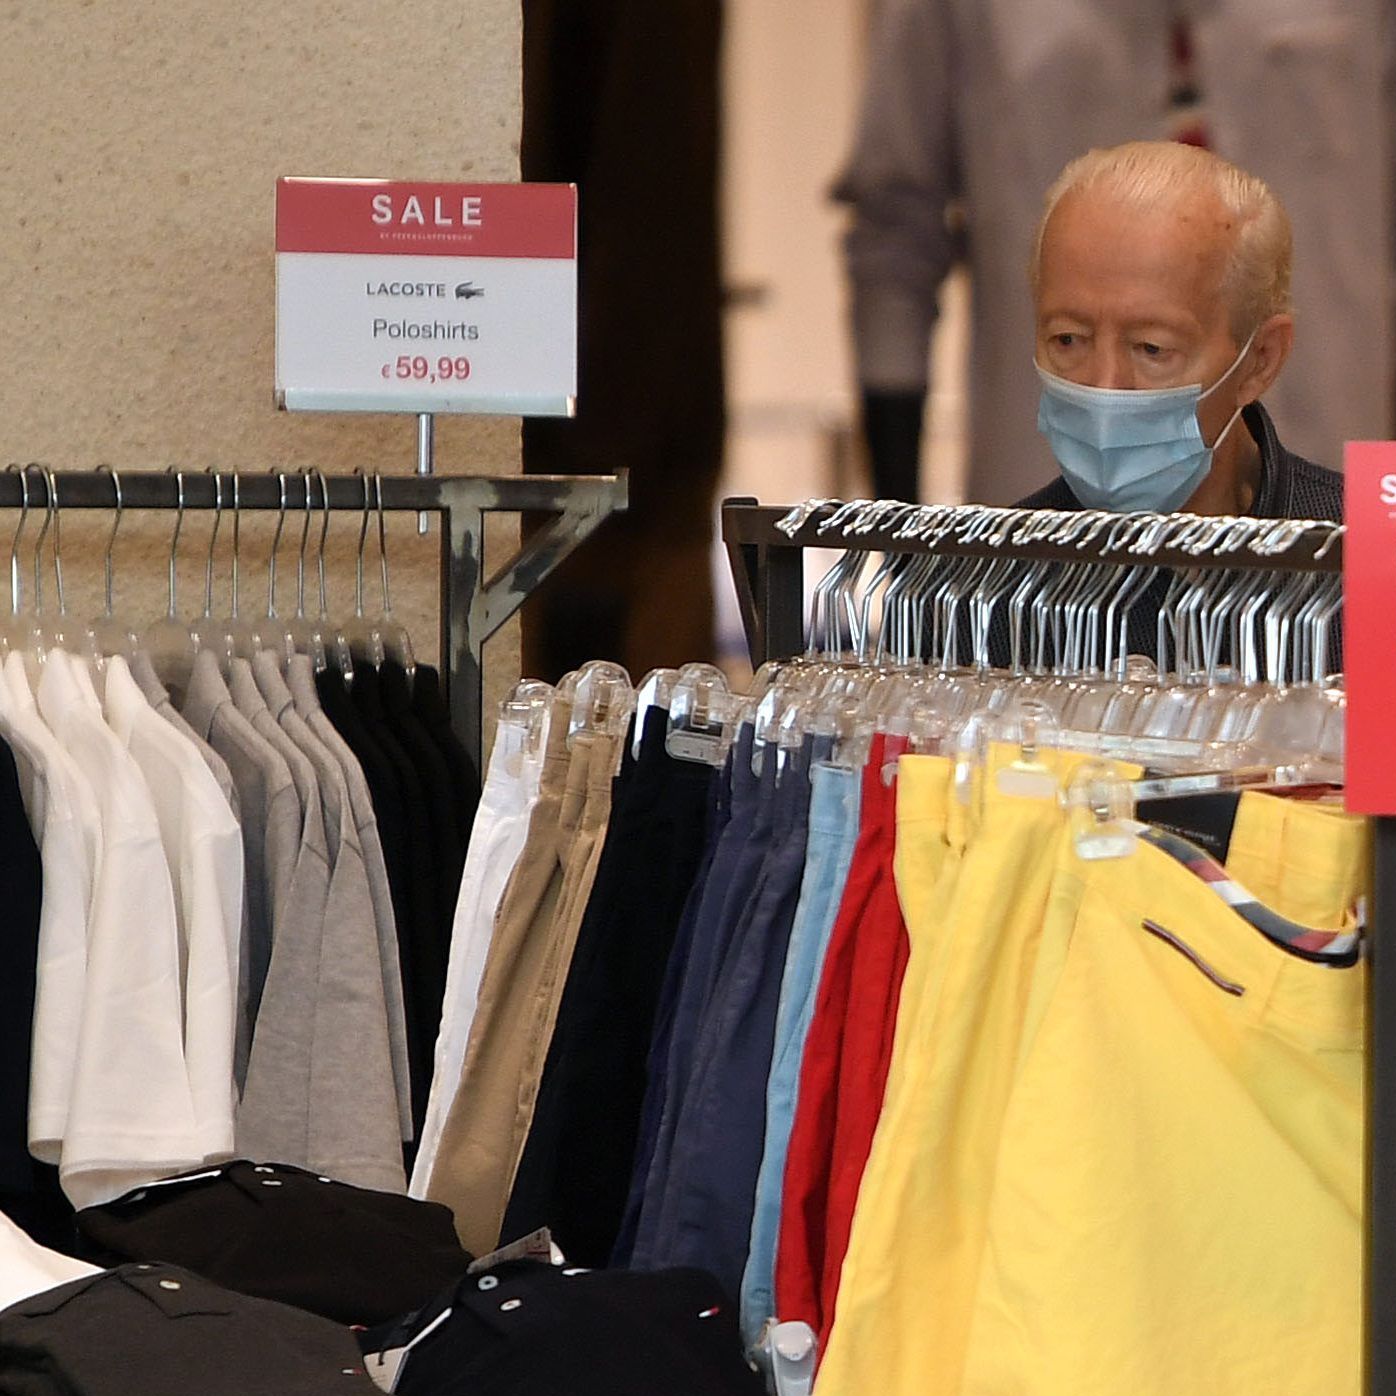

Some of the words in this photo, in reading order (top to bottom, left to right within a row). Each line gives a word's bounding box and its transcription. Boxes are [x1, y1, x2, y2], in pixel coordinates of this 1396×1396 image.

[371, 194, 482, 226] SALE
[366, 282, 446, 297] LACOSTE
[373, 319, 480, 341] Poloshirts
